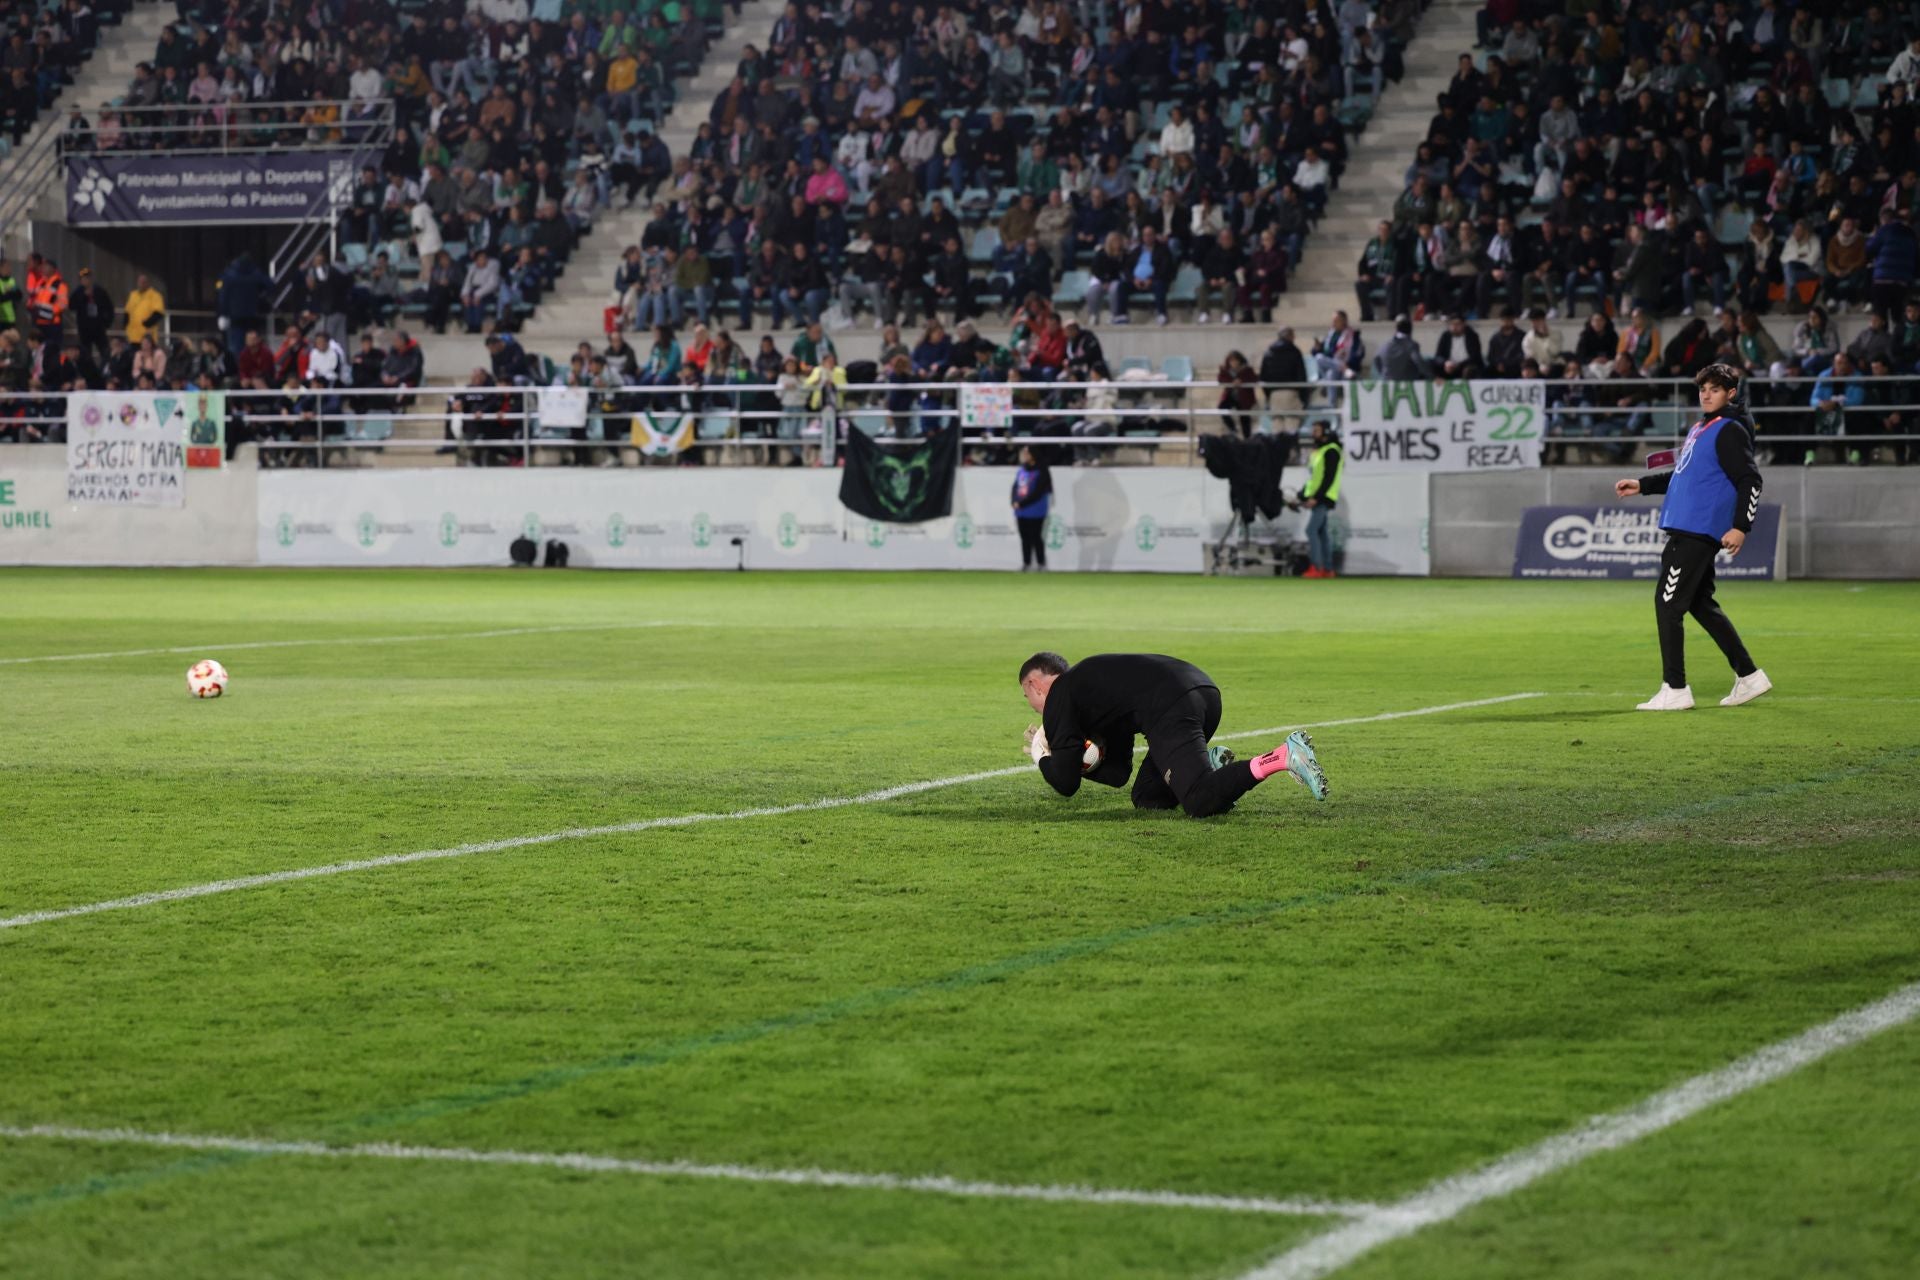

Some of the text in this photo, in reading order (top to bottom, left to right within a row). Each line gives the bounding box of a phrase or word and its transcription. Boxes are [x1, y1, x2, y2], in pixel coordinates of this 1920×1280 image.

[117, 168, 324, 188] Patronato Municipal de Deportes
[138, 191, 308, 211] Ayuntamiento de Palencia
[1451, 421, 1475, 442] LE
[1487, 406, 1537, 440] 22
[1350, 428, 1441, 461] JAMES
[74, 441, 184, 470] SERGIO MATA
[1466, 445, 1523, 468] REZA
[1592, 532, 1670, 545] EL CRIS
[1586, 552, 1662, 565] Hormigon
